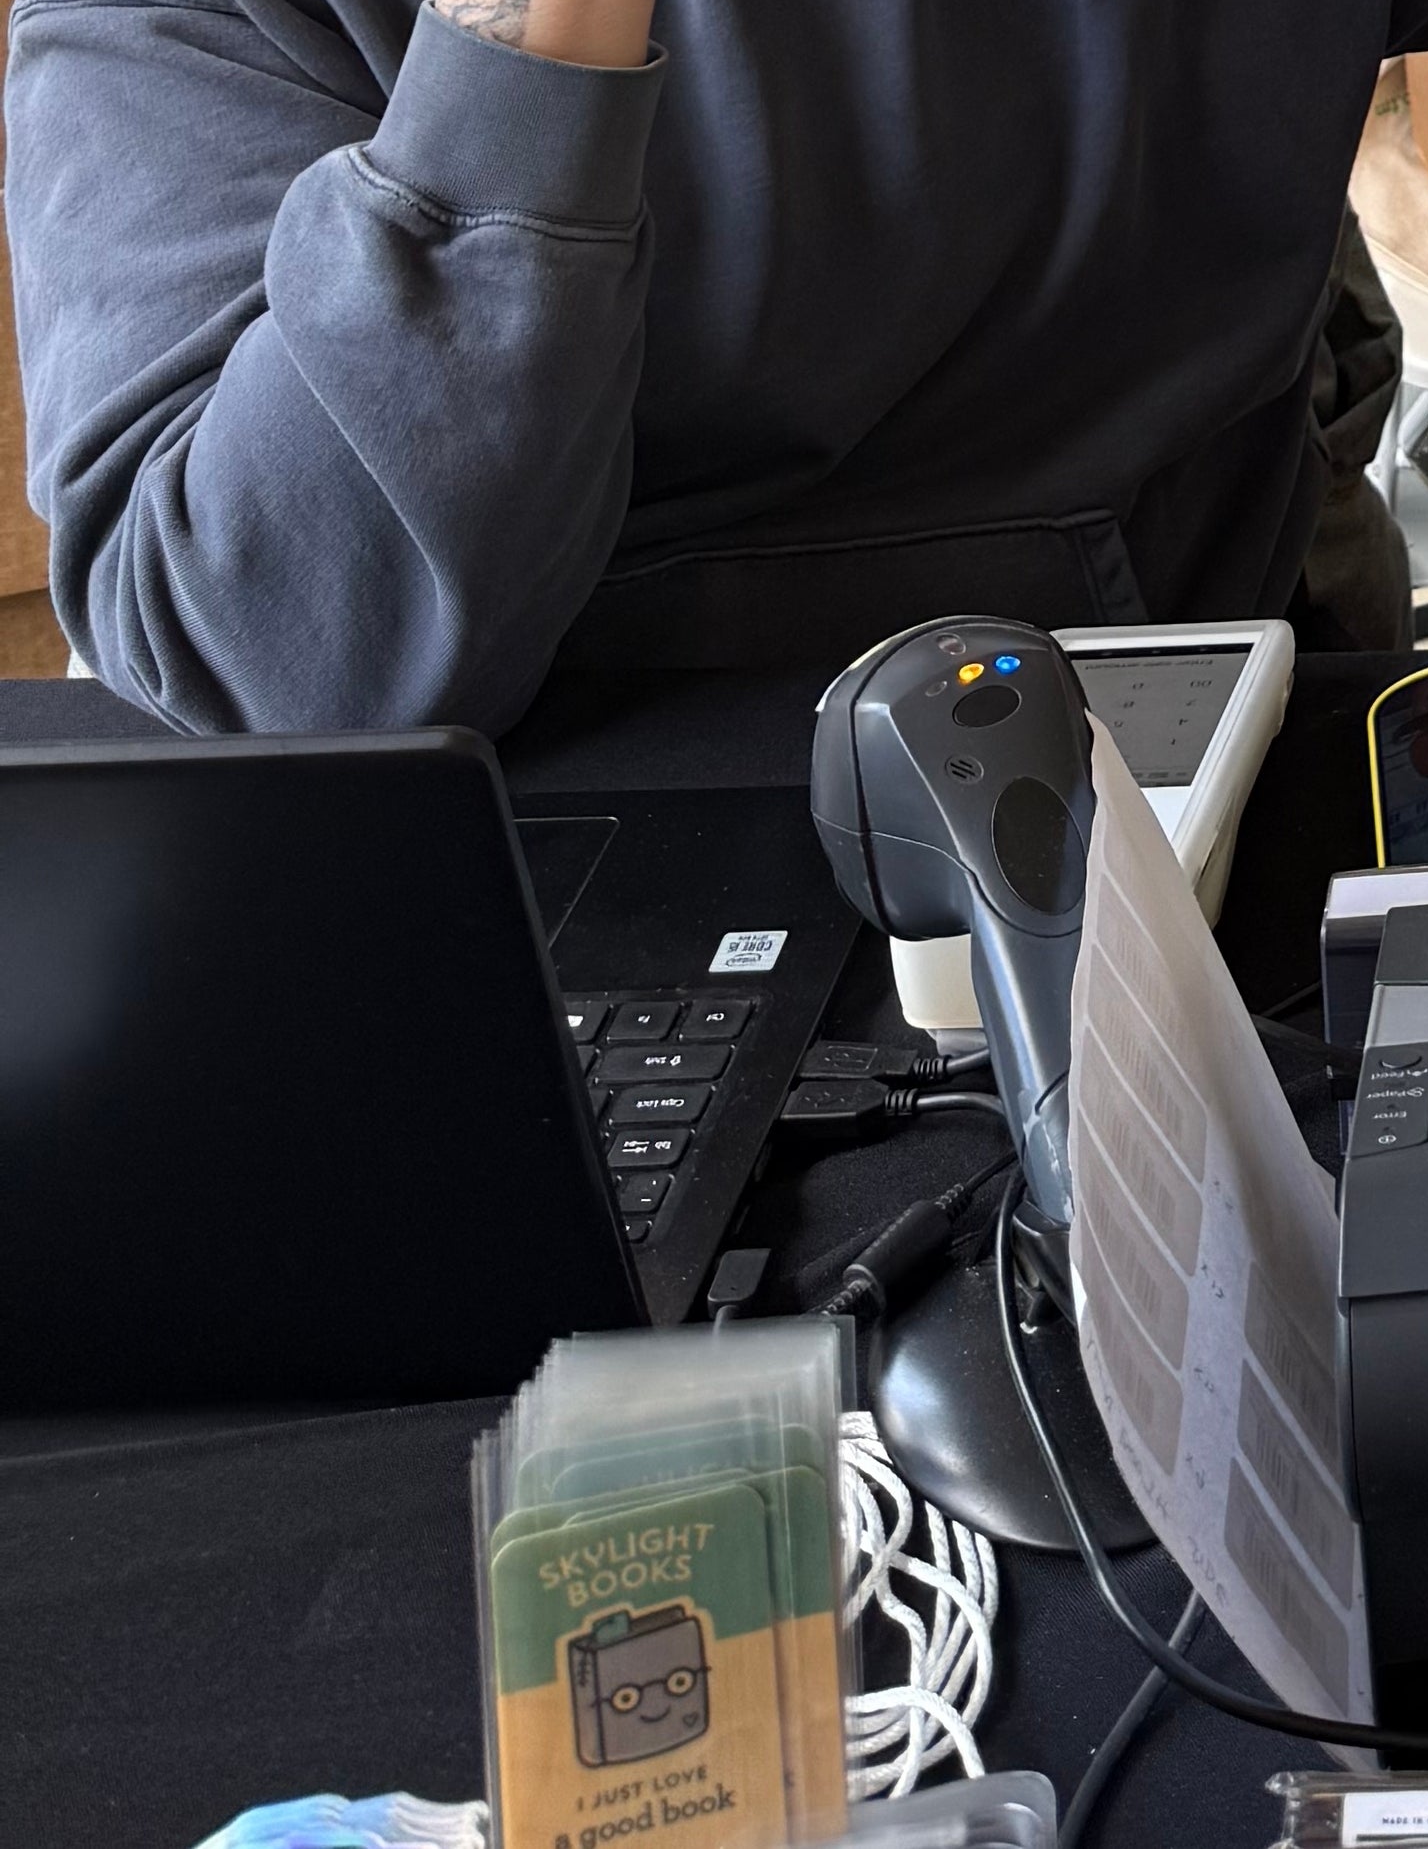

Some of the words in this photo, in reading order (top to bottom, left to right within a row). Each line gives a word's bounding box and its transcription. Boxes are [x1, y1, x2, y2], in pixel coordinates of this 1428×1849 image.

[1371, 1110, 1407, 1119] Error
[539, 1523, 715, 1590] SKYLIGHT
[566, 1554, 693, 1608] BOOKS
[577, 1796, 585, 1812] I
[590, 1780, 644, 1809] JUST
[651, 1765, 709, 1793] LOVE
[579, 1808, 655, 1849] good
[662, 1782, 737, 1825] book
